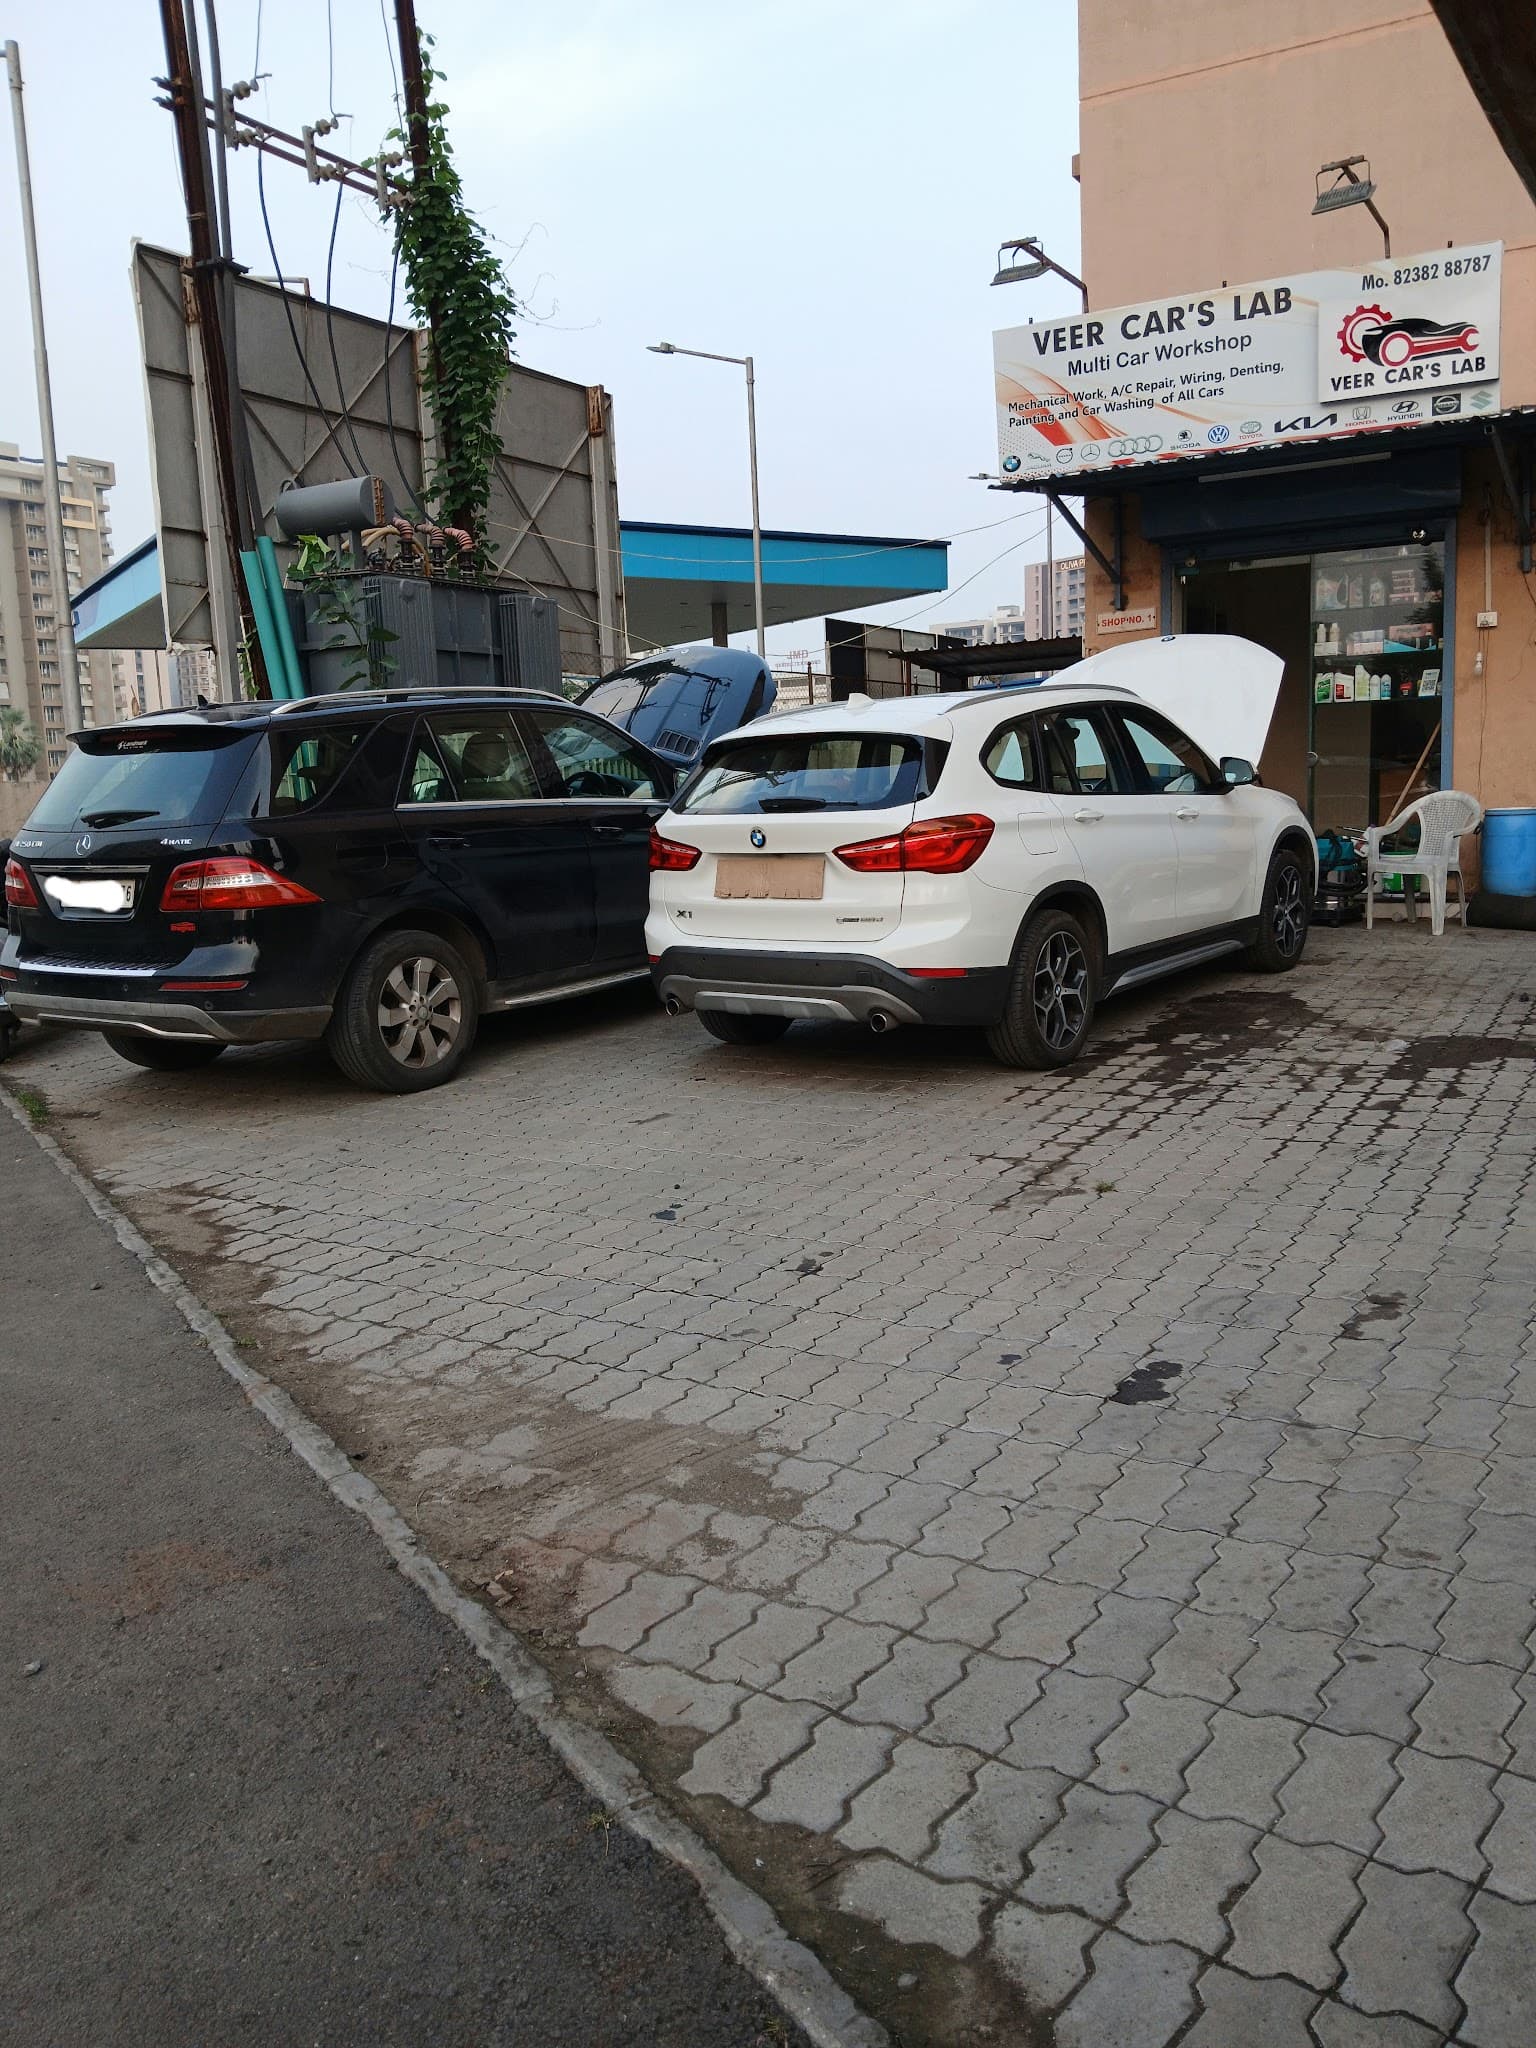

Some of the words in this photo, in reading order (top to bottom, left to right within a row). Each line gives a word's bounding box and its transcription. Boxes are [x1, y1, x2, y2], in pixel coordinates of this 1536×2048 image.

[1361, 274, 1388, 291] Mo.
[1393, 263, 1439, 286] 82382
[1444, 254, 1492, 278] 88787
[1032, 321, 1104, 356] VEER
[1120, 300, 1215, 340] CAR'S
[1233, 287, 1292, 321] LAB
[1068, 355, 1110, 376] Multi
[1116, 351, 1150, 368] Car
[1155, 334, 1252, 361] Workshop
[1008, 394, 1069, 412] Mechanical
[1073, 388, 1107, 402] Work,
[1111, 384, 1132, 397] A/C
[1136, 377, 1176, 394] Repair,
[1180, 371, 1225, 386] Wiring,
[1230, 361, 1284, 378] Denting,
[1331, 372, 1375, 392] VEER
[1384, 362, 1441, 384] CAR'S
[1451, 356, 1486, 375] LAB
[1009, 412, 1055, 428] Painting
[1058, 408, 1079, 420] and
[1082, 405, 1101, 416] Car
[1104, 398, 1155, 413] Washing
[1161, 392, 1175, 404] of
[1177, 389, 1194, 402] All
[1198, 386, 1224, 398] Cars
[1345, 418, 1378, 427] HONDA
[1387, 412, 1423, 422] HYUNDAI
[1101, 617, 1126, 627] SHOP
[1129, 615, 1144, 624] NO.
[1147, 614, 1152, 622] 1
[675, 909, 693, 919] X1
